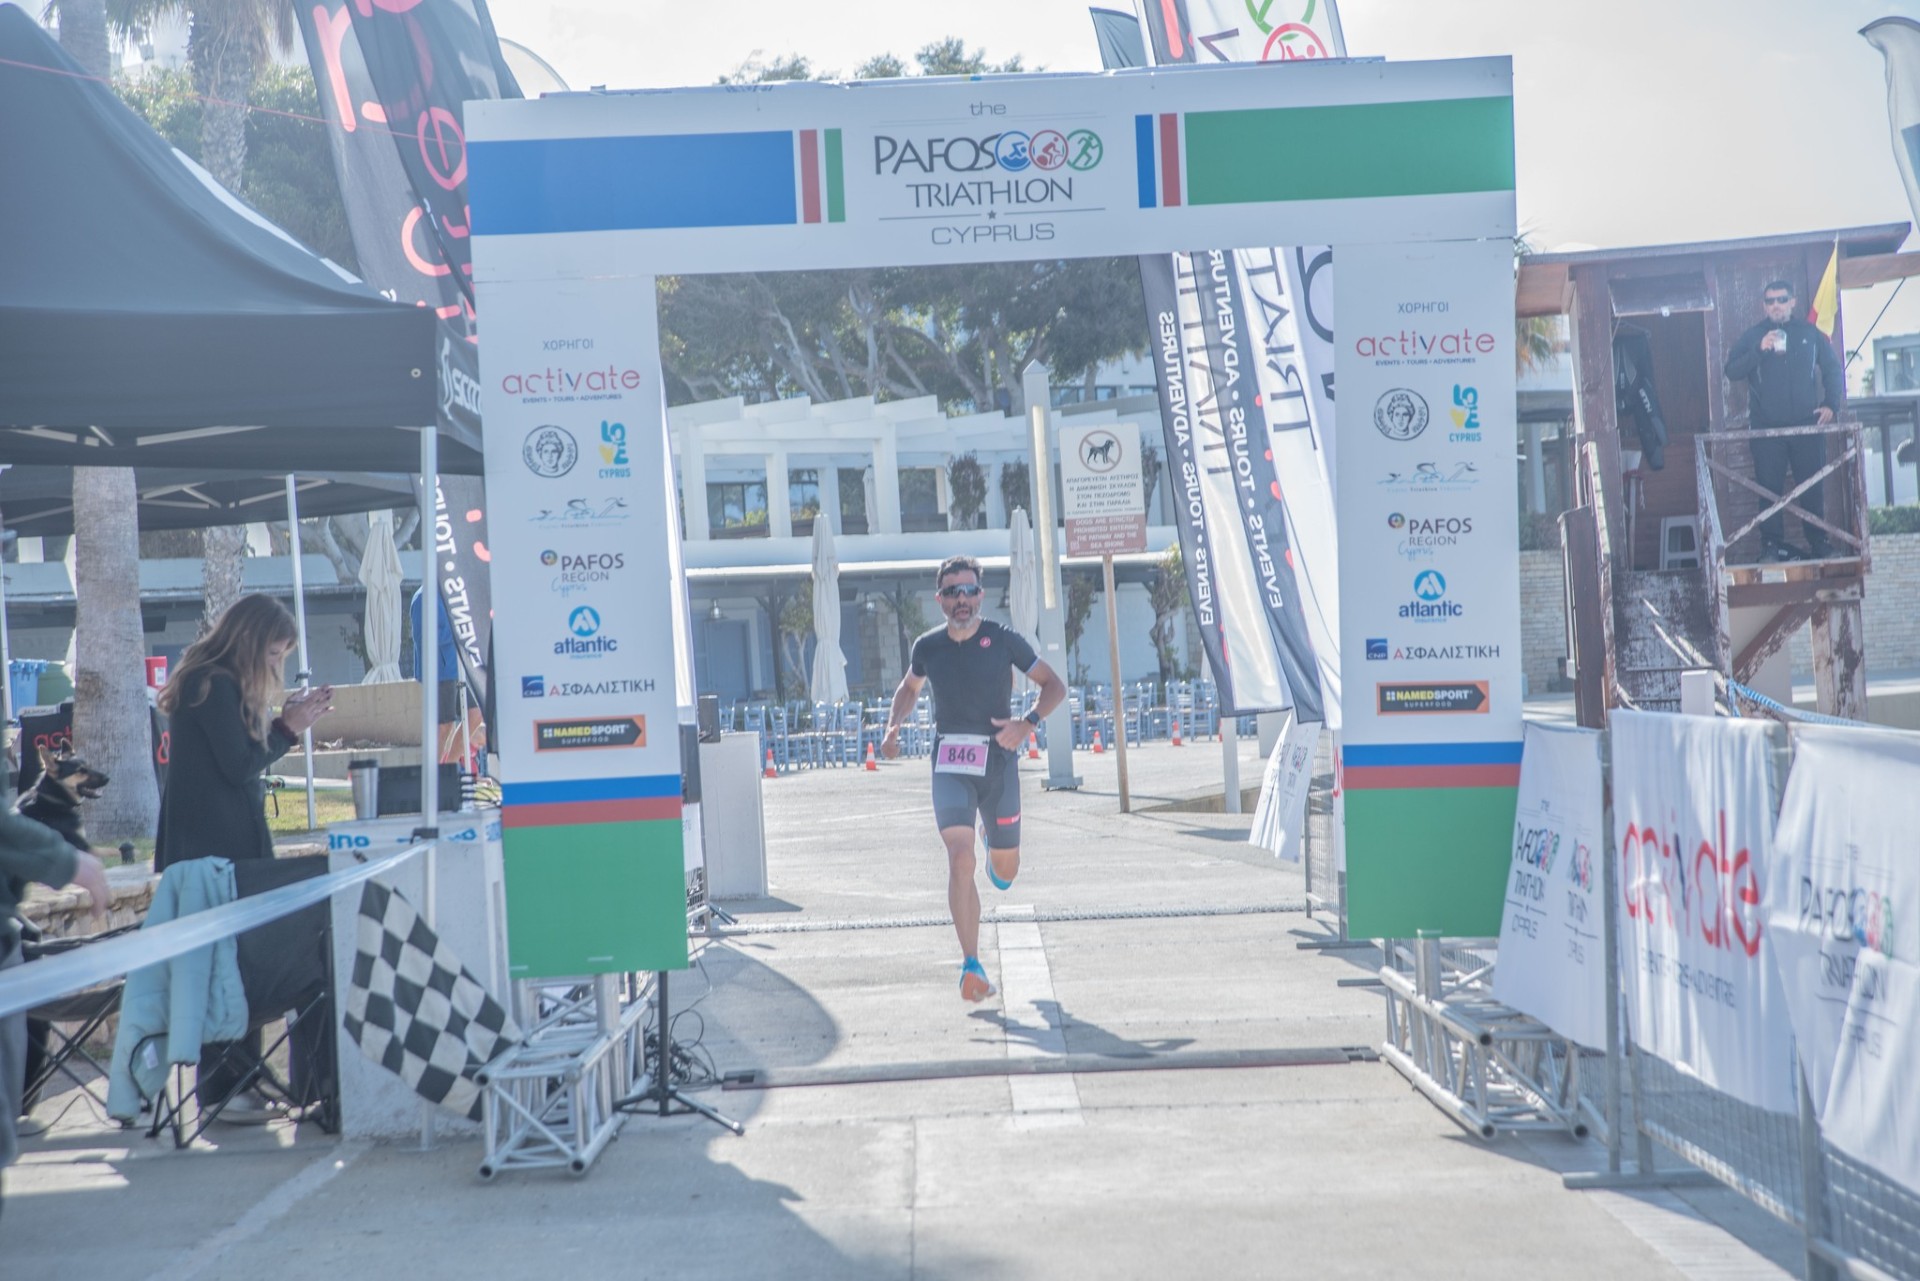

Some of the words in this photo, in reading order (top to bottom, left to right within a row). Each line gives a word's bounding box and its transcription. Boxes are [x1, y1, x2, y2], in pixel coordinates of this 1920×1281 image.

[969, 101, 1006, 116] the
[874, 133, 1002, 175] PAFOS
[905, 177, 1073, 208] TRIATHLON
[932, 223, 1055, 245] CYPRUS
[1356, 328, 1495, 357] activate
[1433, 357, 1476, 365] ADVENTURES
[502, 364, 641, 394] activate
[580, 393, 623, 401] ADVENTURES
[1449, 432, 1482, 442] CYPRUS
[599, 467, 631, 479] CYPRUS
[1409, 517, 1473, 535] PAFOS
[1409, 536, 1457, 546] REGION
[561, 553, 625, 571] PAFOS
[561, 571, 610, 583] REGION
[1398, 600, 1463, 618] atlantic
[554, 636, 618, 655] atlantic
[1393, 645, 1500, 660] ΑΣΦΑΛΙΣΤΙΚΗ
[549, 679, 656, 697] ΑΣΦΑΛΙΣΤΙΚΗ
[1404, 701, 1452, 709] SUPERFOOD
[561, 736, 610, 745] SUPERFOOD
[948, 747, 976, 763] 846
